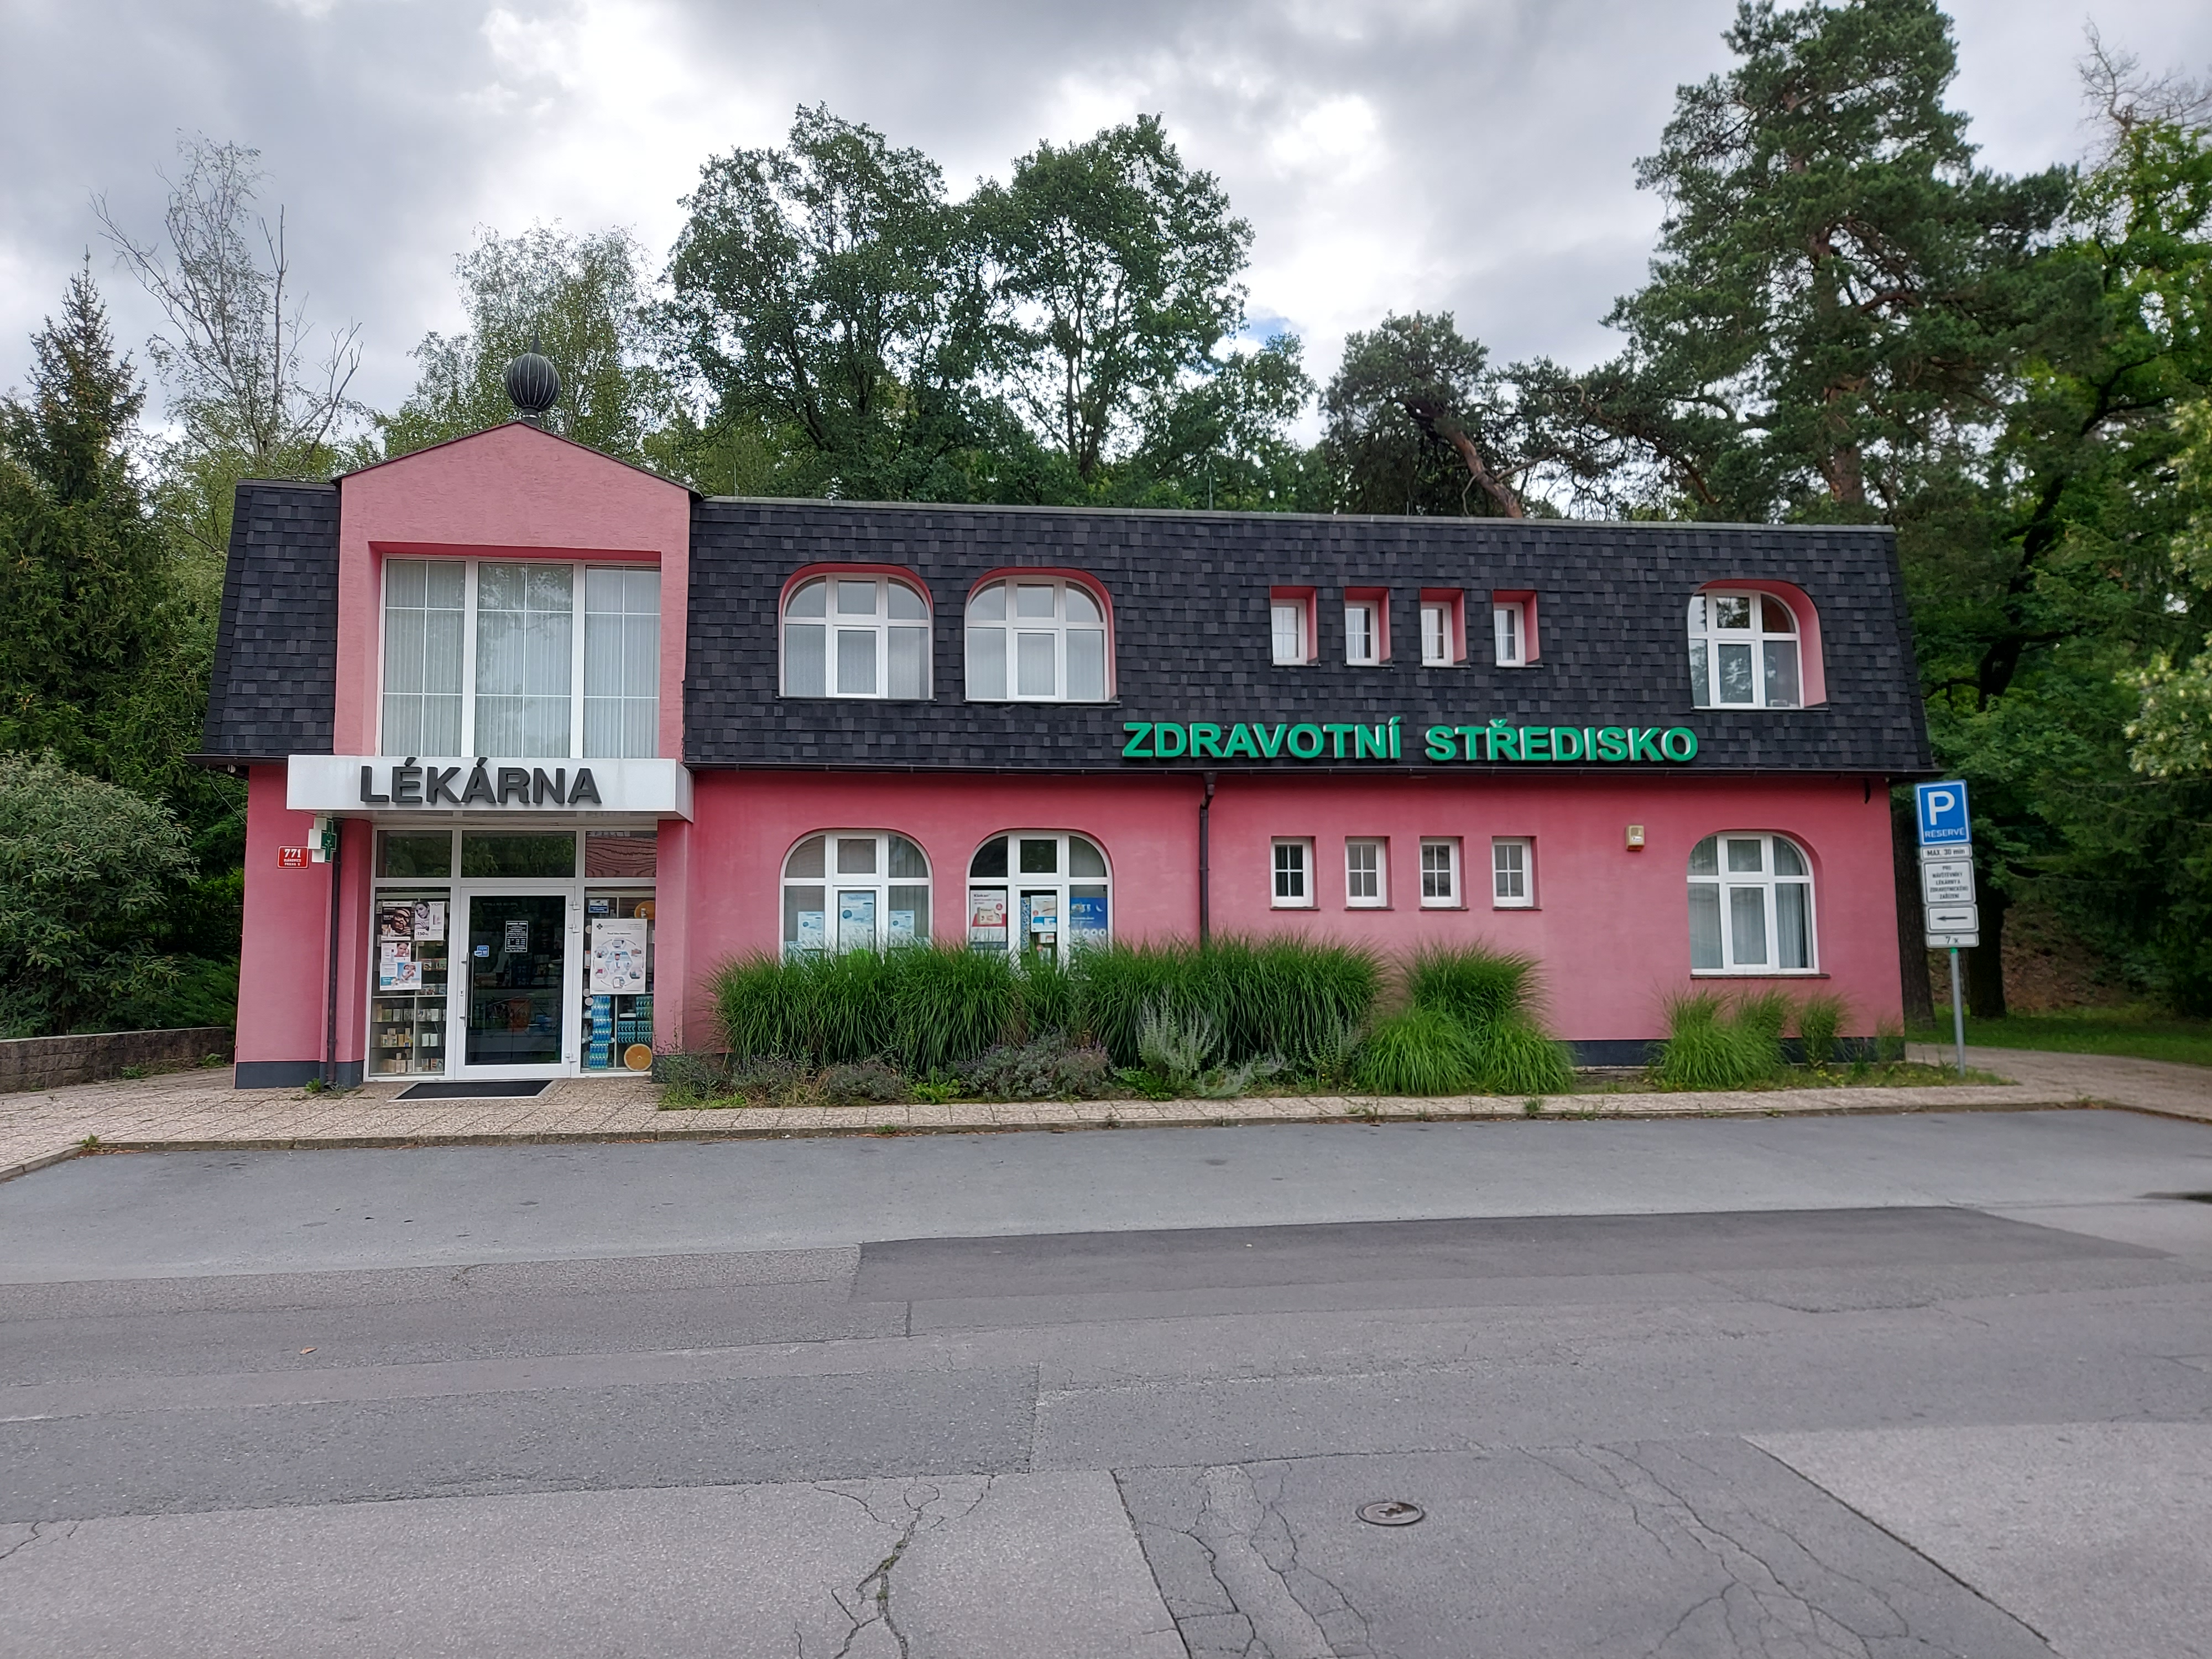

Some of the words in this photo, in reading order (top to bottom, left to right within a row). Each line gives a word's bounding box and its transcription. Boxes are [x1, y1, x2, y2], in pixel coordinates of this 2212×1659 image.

[1122, 716, 1402, 759] ZDRAVOTNÍ
[1425, 718, 1698, 761] STŘEDISKO
[360, 757, 602, 804] LÉKÁRNA
[1928, 791, 1955, 826] P
[1924, 827, 1965, 838] RESERVÉ
[284, 848, 301, 858] 771
[1945, 936, 1951, 944] 7
